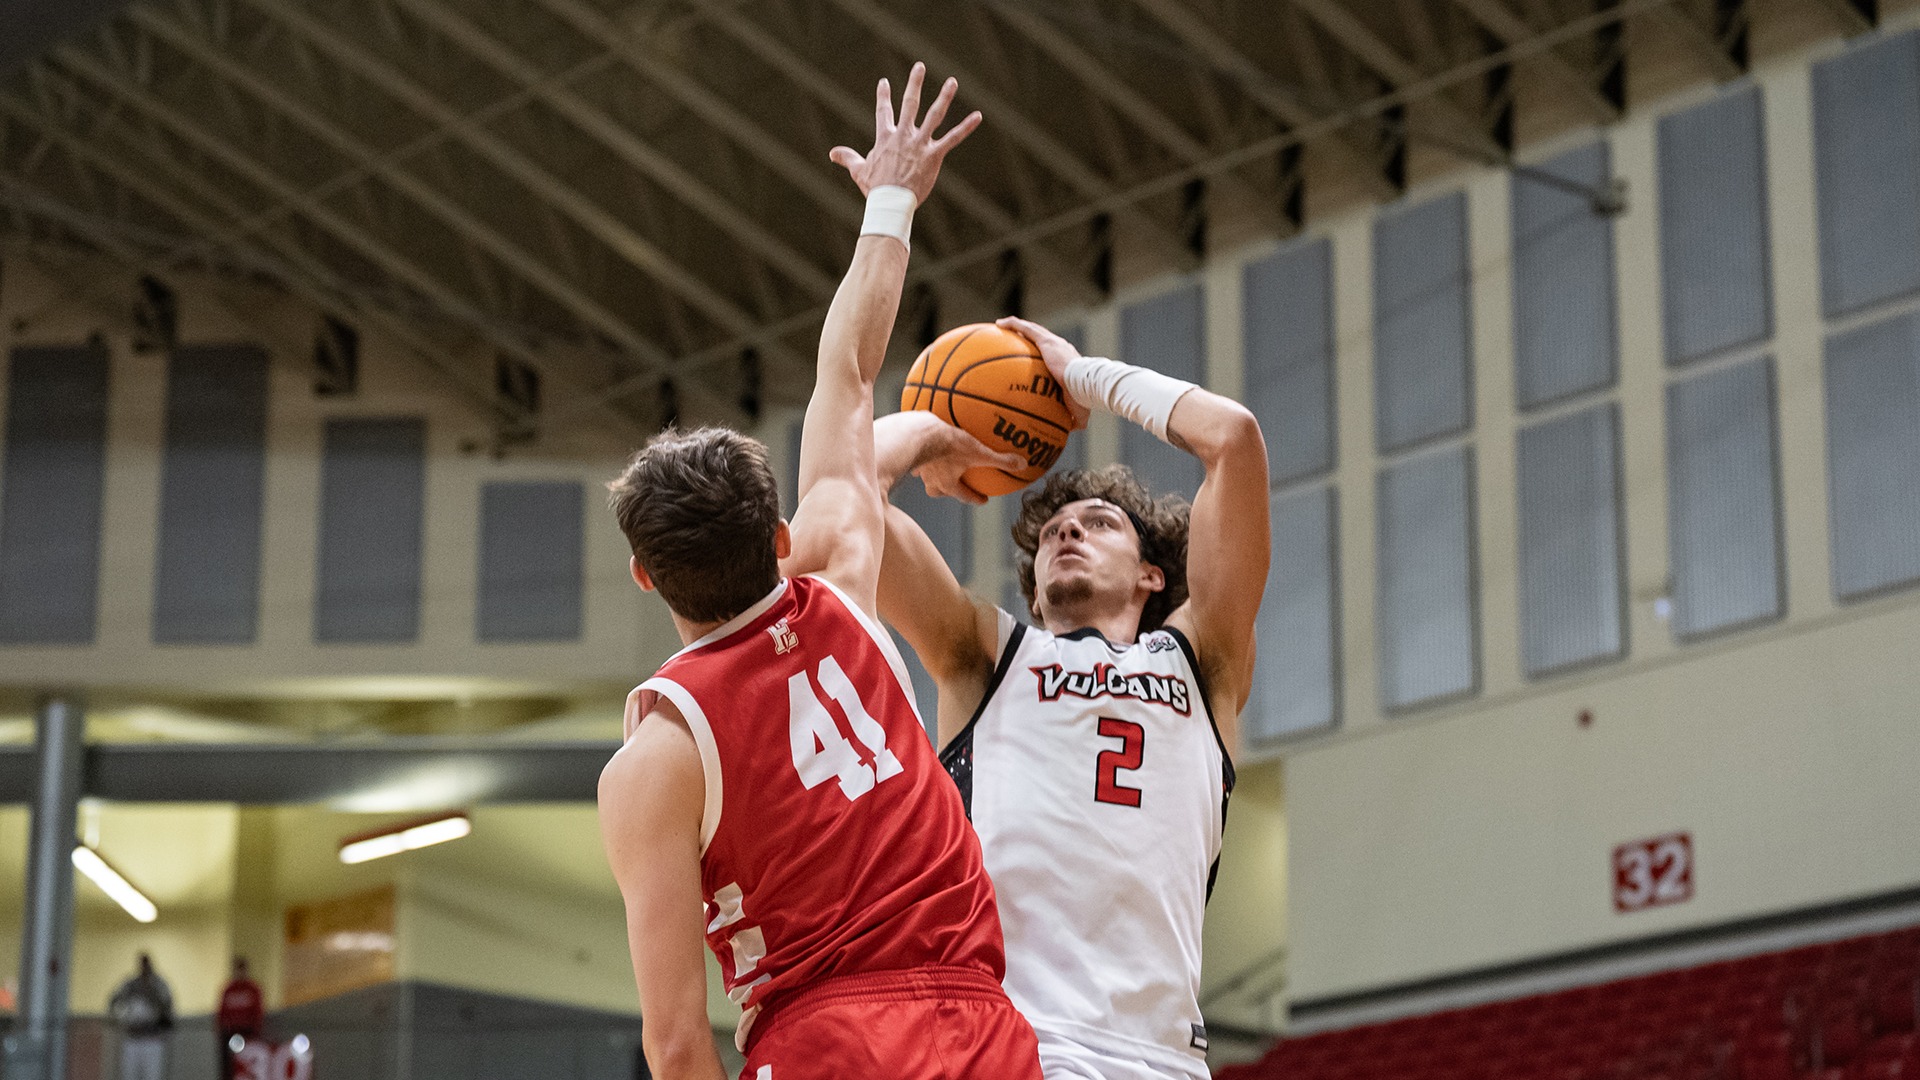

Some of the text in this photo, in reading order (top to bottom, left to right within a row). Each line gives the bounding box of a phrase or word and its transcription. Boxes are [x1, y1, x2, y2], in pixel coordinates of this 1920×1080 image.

[1031, 374, 1066, 407] VO
[1030, 663, 1192, 718] VULCANS
[788, 654, 904, 802] 41
[1094, 716, 1145, 809] 2
[1619, 841, 1688, 906] 32
